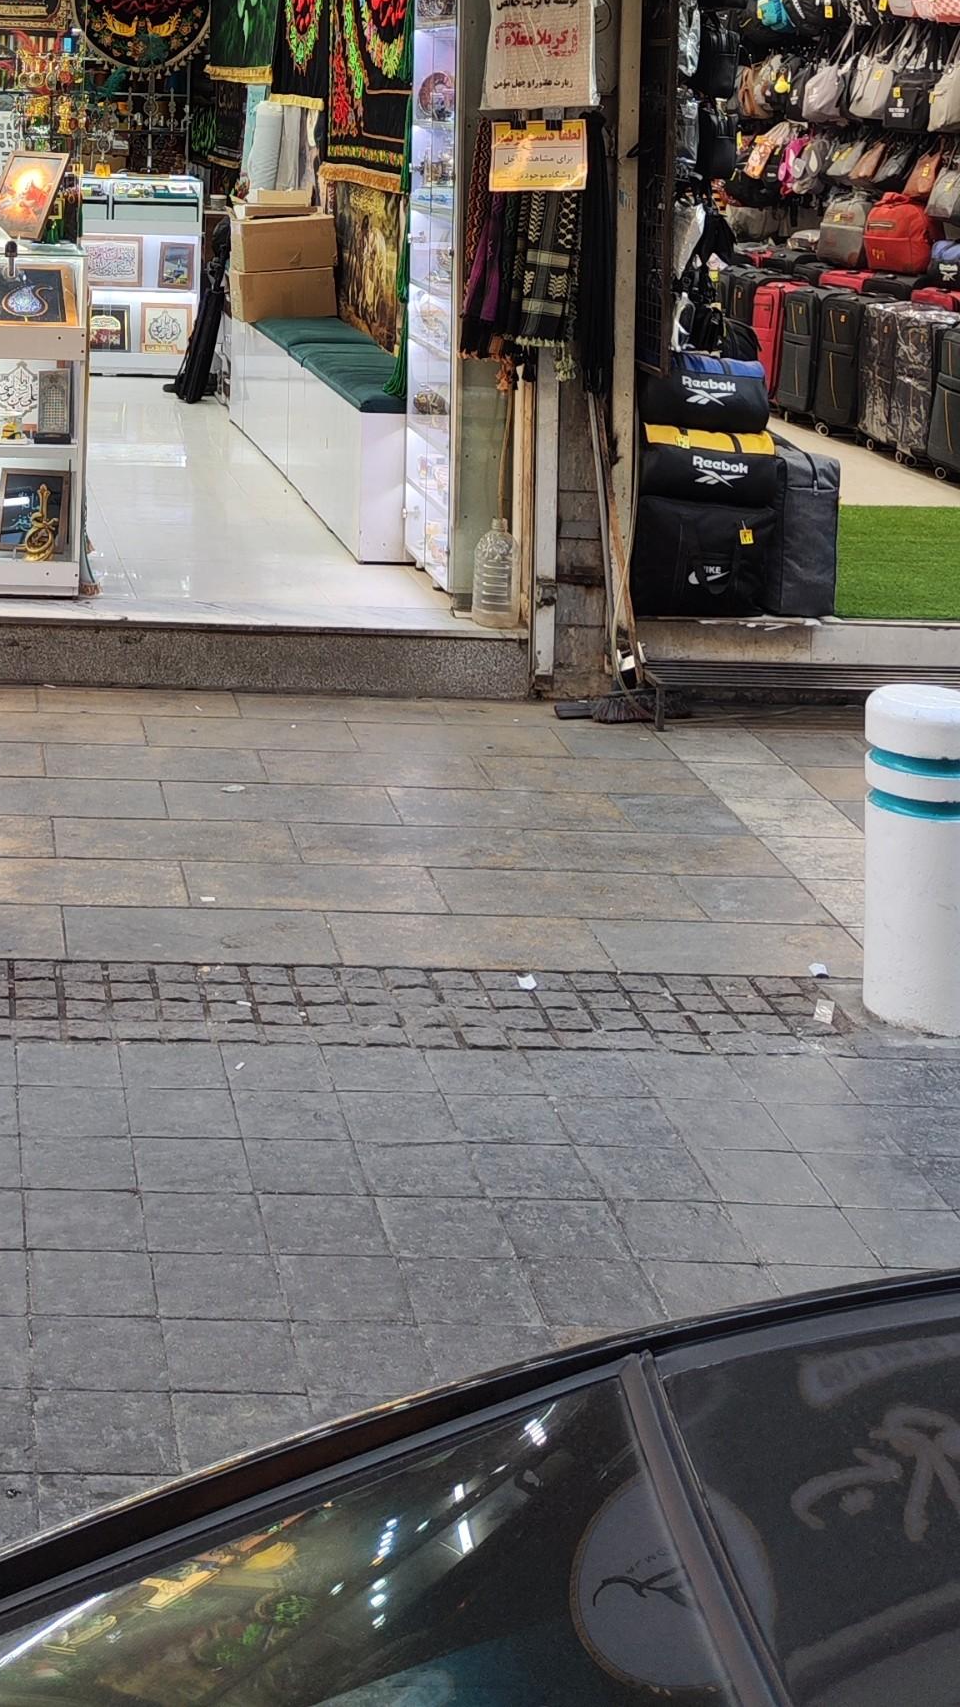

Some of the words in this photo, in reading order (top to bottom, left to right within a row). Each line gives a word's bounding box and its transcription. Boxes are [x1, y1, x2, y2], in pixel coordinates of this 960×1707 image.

[537, 29, 568, 50] کربلا
[557, 154, 573, 164] برای
[681, 375, 737, 393] Reebok
[692, 455, 749, 475] Reebok
[704, 565, 722, 575] IKE
